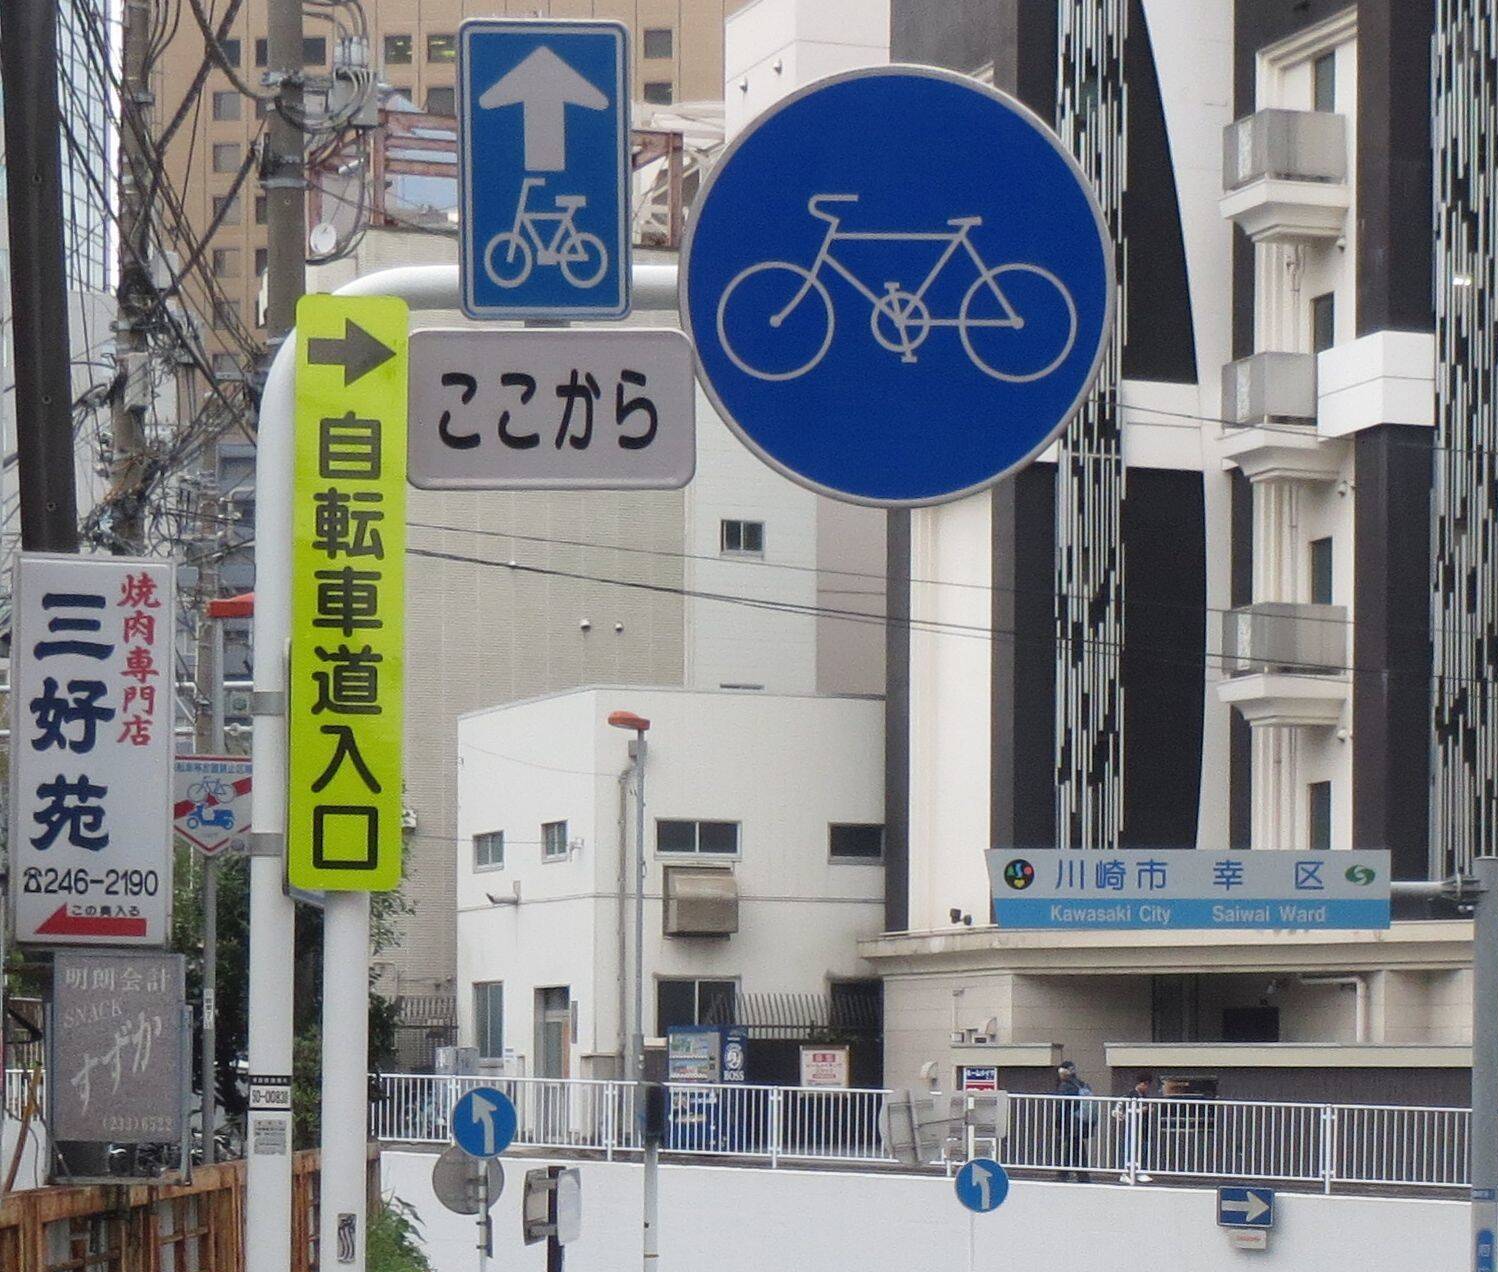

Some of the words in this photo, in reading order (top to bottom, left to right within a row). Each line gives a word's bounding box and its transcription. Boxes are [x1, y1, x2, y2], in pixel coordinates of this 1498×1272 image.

[438, 368, 658, 450] ここから
[311, 410, 385, 871] 自転車道入口
[116, 572, 162, 747] 焼肉専門店
[29, 592, 116, 852] 三好苑
[44, 867, 159, 896] 246-2190
[1055, 859, 1168, 891] 川崎市
[1050, 904, 1132, 923] Kawasaki
[1139, 904, 1171, 926] City
[1212, 904, 1270, 923] Saiwai
[1279, 905, 1328, 923] Ward
[65, 967, 171, 992] 明朗会計
[63, 997, 123, 1029] SNACK
[723, 1070, 745, 1081] BOSS
